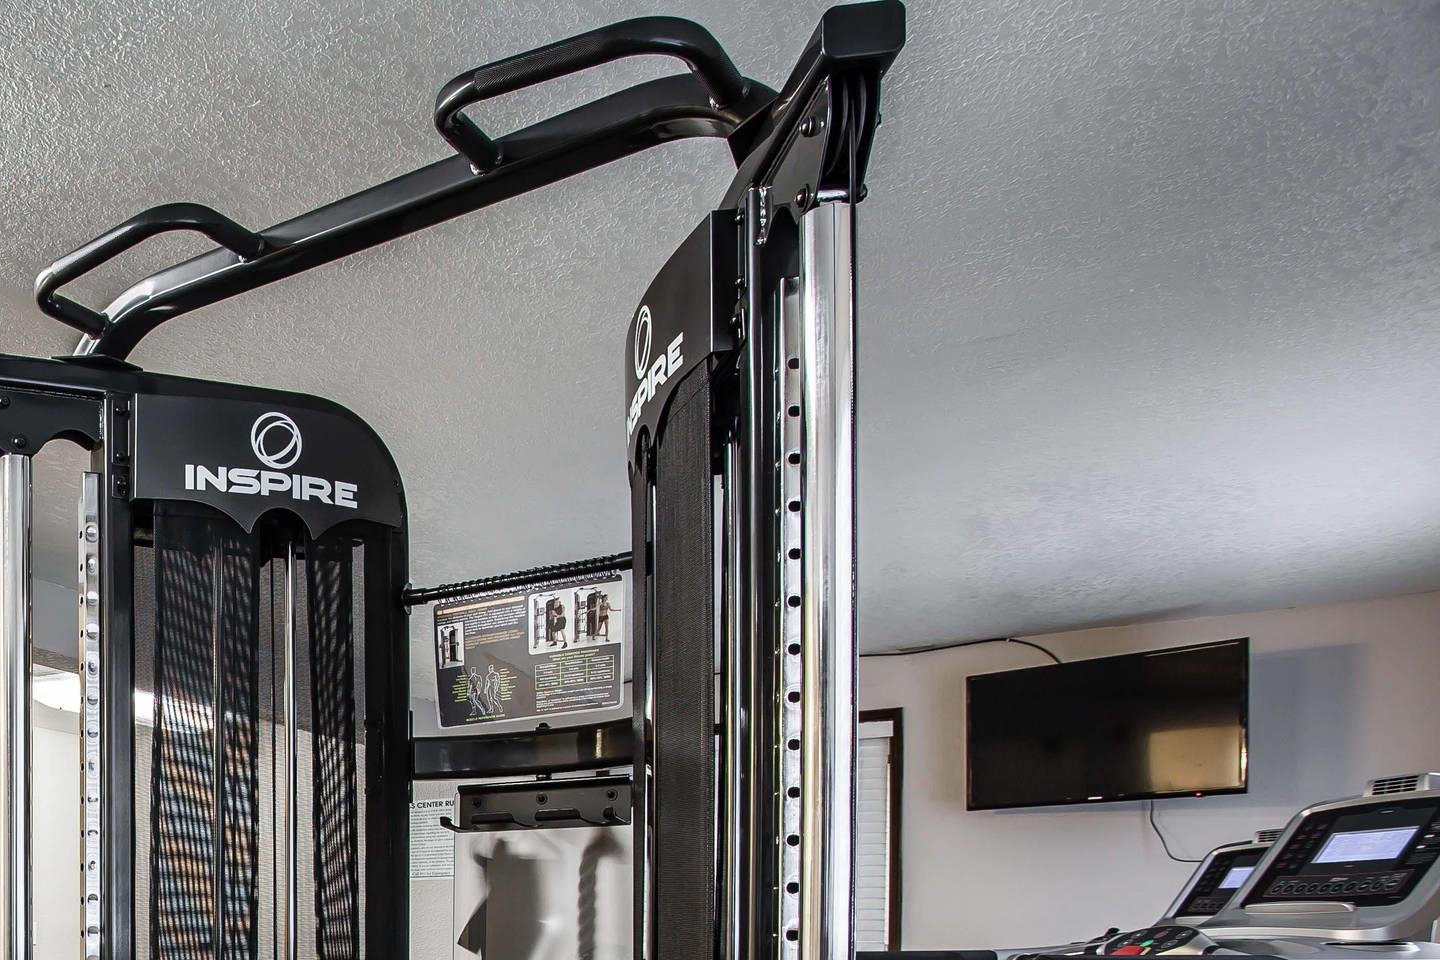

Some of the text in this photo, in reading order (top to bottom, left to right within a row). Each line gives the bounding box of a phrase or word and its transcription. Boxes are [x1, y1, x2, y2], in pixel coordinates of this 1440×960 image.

[626, 332, 684, 448] NSPIRE
[184, 464, 358, 509] INSPIRE
[416, 800, 444, 809] CENTER
[445, 799, 455, 807] RU
